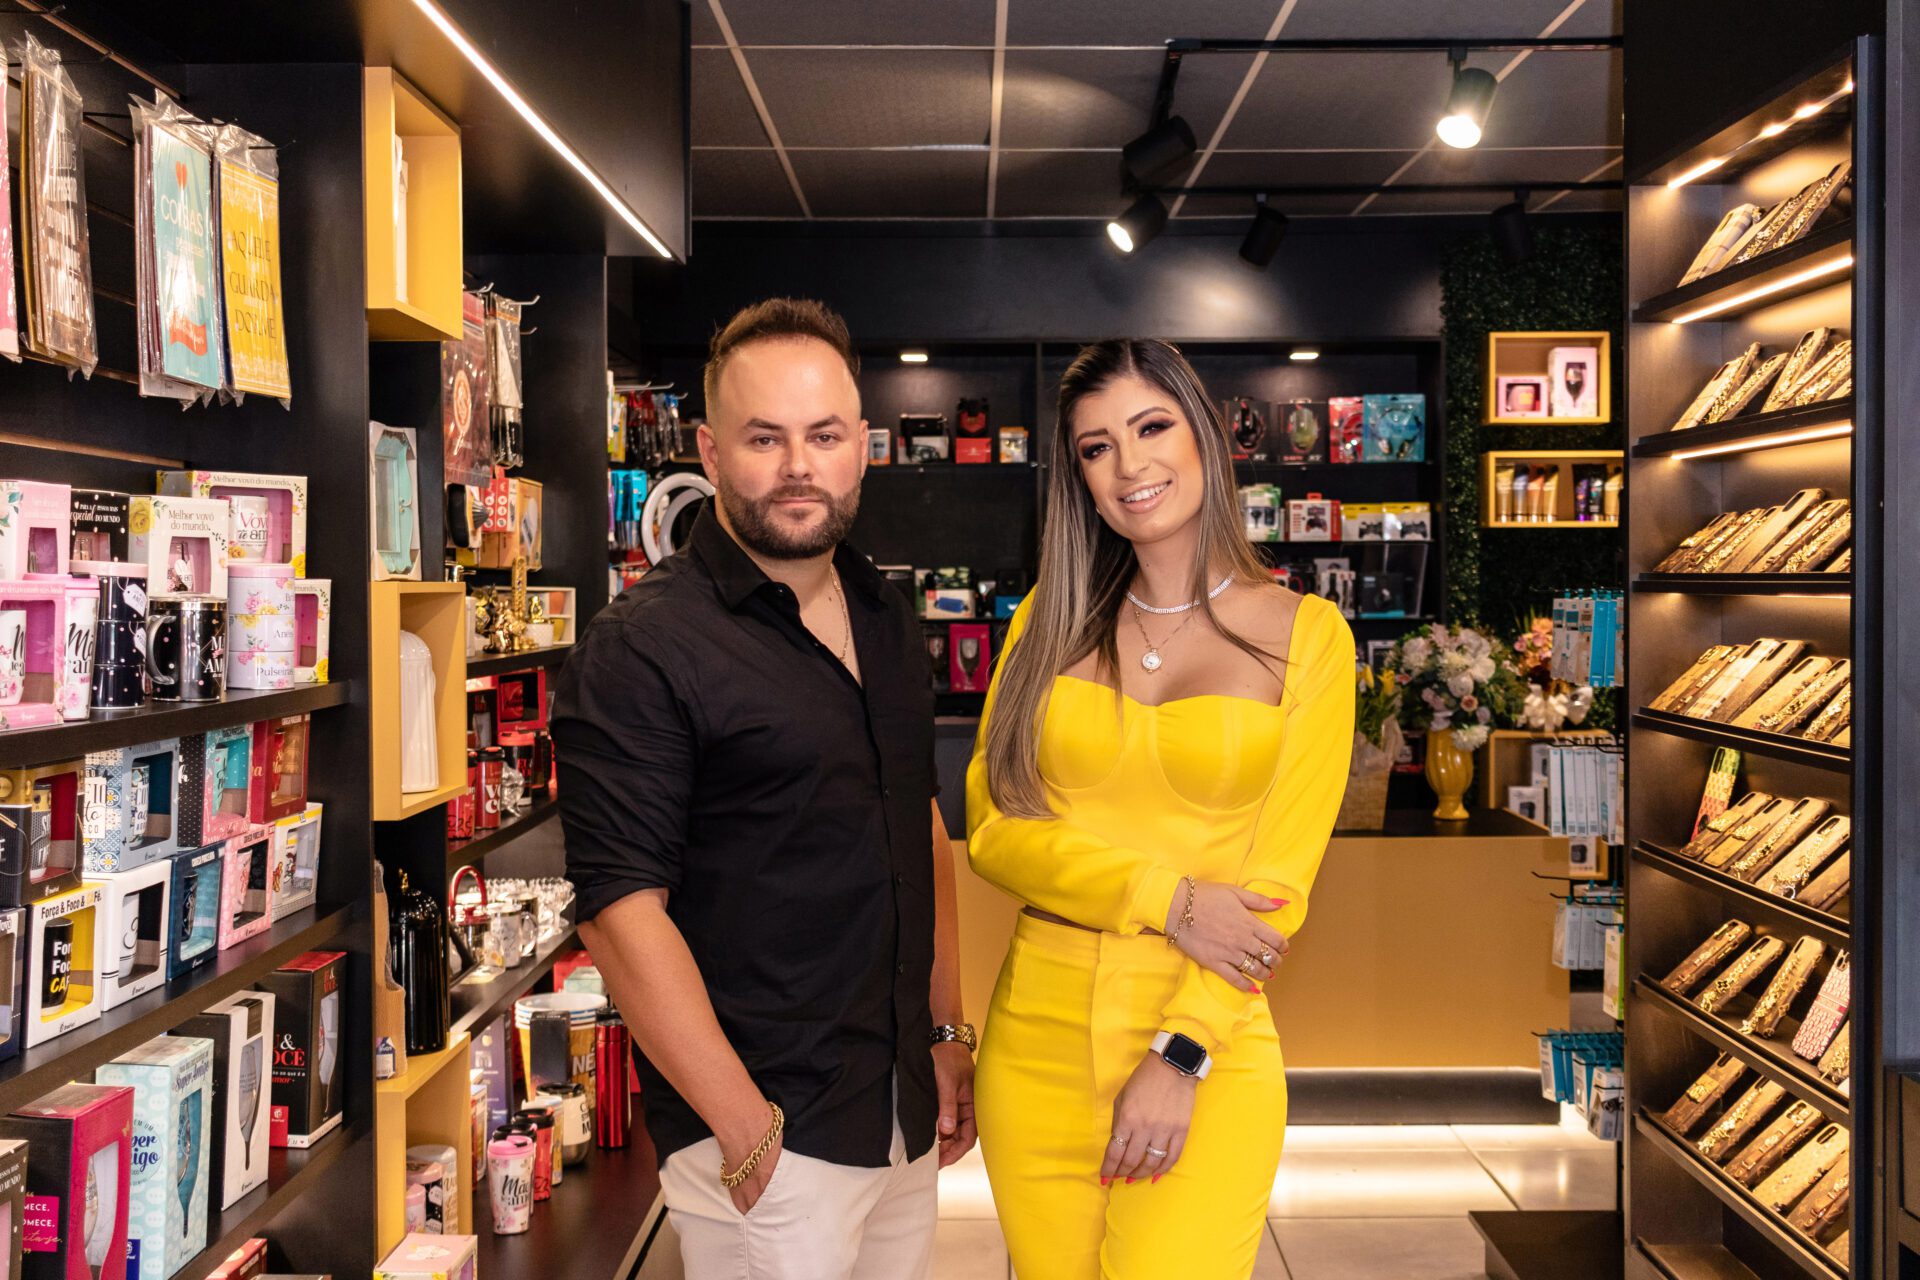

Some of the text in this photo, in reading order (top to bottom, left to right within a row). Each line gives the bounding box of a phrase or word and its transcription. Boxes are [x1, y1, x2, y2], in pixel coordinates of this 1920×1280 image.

[168, 509, 193, 522] Melhor
[170, 519, 211, 531] do mundo.
[41, 905, 60, 920] Força
[60, 902, 65, 913] &
[66, 898, 80, 912] Foco
[80, 896, 85, 907] &
[280, 1033, 296, 1051] &
